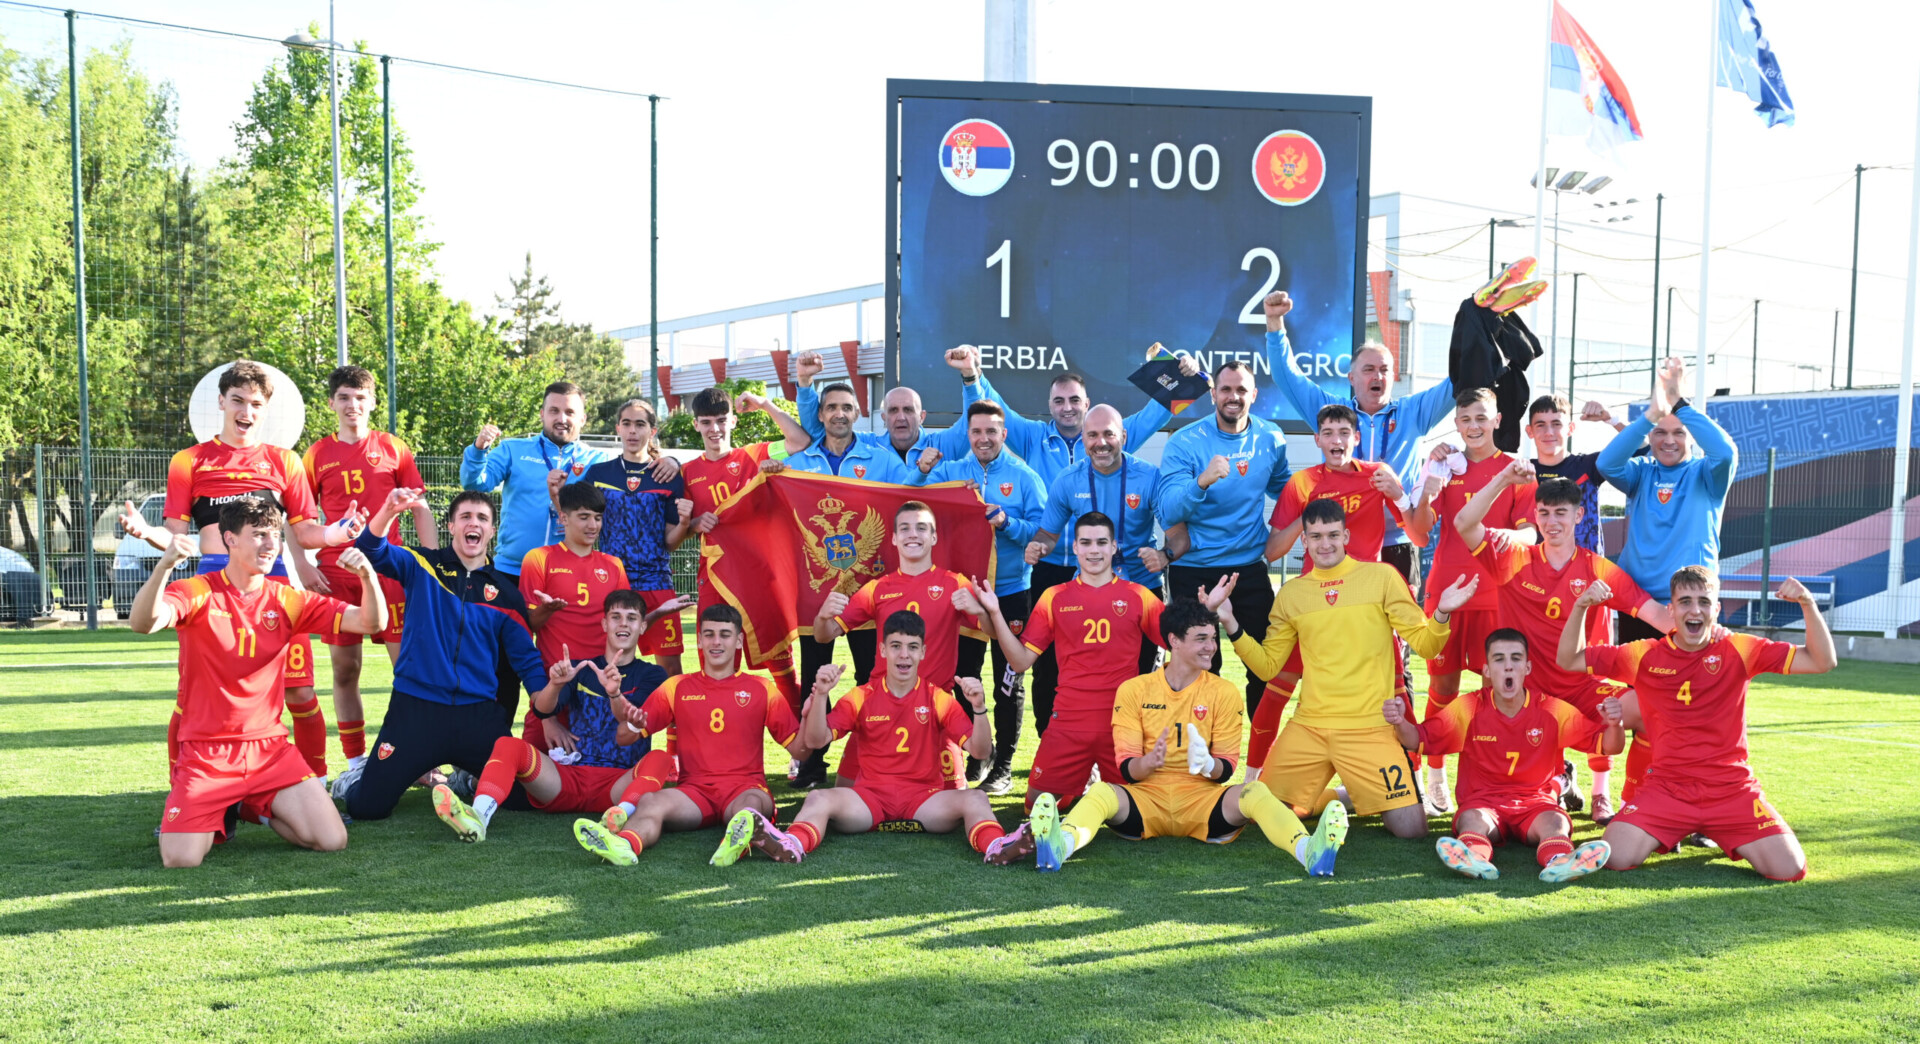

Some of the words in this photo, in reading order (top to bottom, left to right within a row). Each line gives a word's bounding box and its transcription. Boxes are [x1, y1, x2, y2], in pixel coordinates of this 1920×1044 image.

[1047, 139, 1221, 191] 90:00
[985, 239, 1011, 318] 1
[1238, 247, 1281, 325] 2
[977, 345, 1069, 370] ERBIA
[1172, 349, 1352, 378] NTENGRO
[341, 469, 365, 495] 13
[708, 481, 732, 506] 10
[1340, 494, 1362, 513] 16
[577, 582, 590, 606] 5
[880, 592, 903, 600] LEGEA
[1320, 579, 1344, 588] LEGEA
[1521, 581, 1546, 595] LEGEA
[1059, 605, 1084, 613] LEGEA
[1545, 596, 1562, 619] 6
[237, 627, 256, 658] 11
[663, 619, 676, 642] 3
[1083, 618, 1111, 643] 20
[286, 643, 305, 670] 8
[1648, 666, 1677, 675] LEGEA
[1676, 680, 1692, 706] 4
[710, 707, 725, 733] 8
[895, 726, 910, 753] 2
[1174, 722, 1182, 747] 1
[940, 749, 954, 775] 9
[1505, 751, 1520, 776] 7
[1379, 764, 1407, 792] 12
[1385, 789, 1411, 801] LEGEA
[1753, 798, 1772, 819] 4
